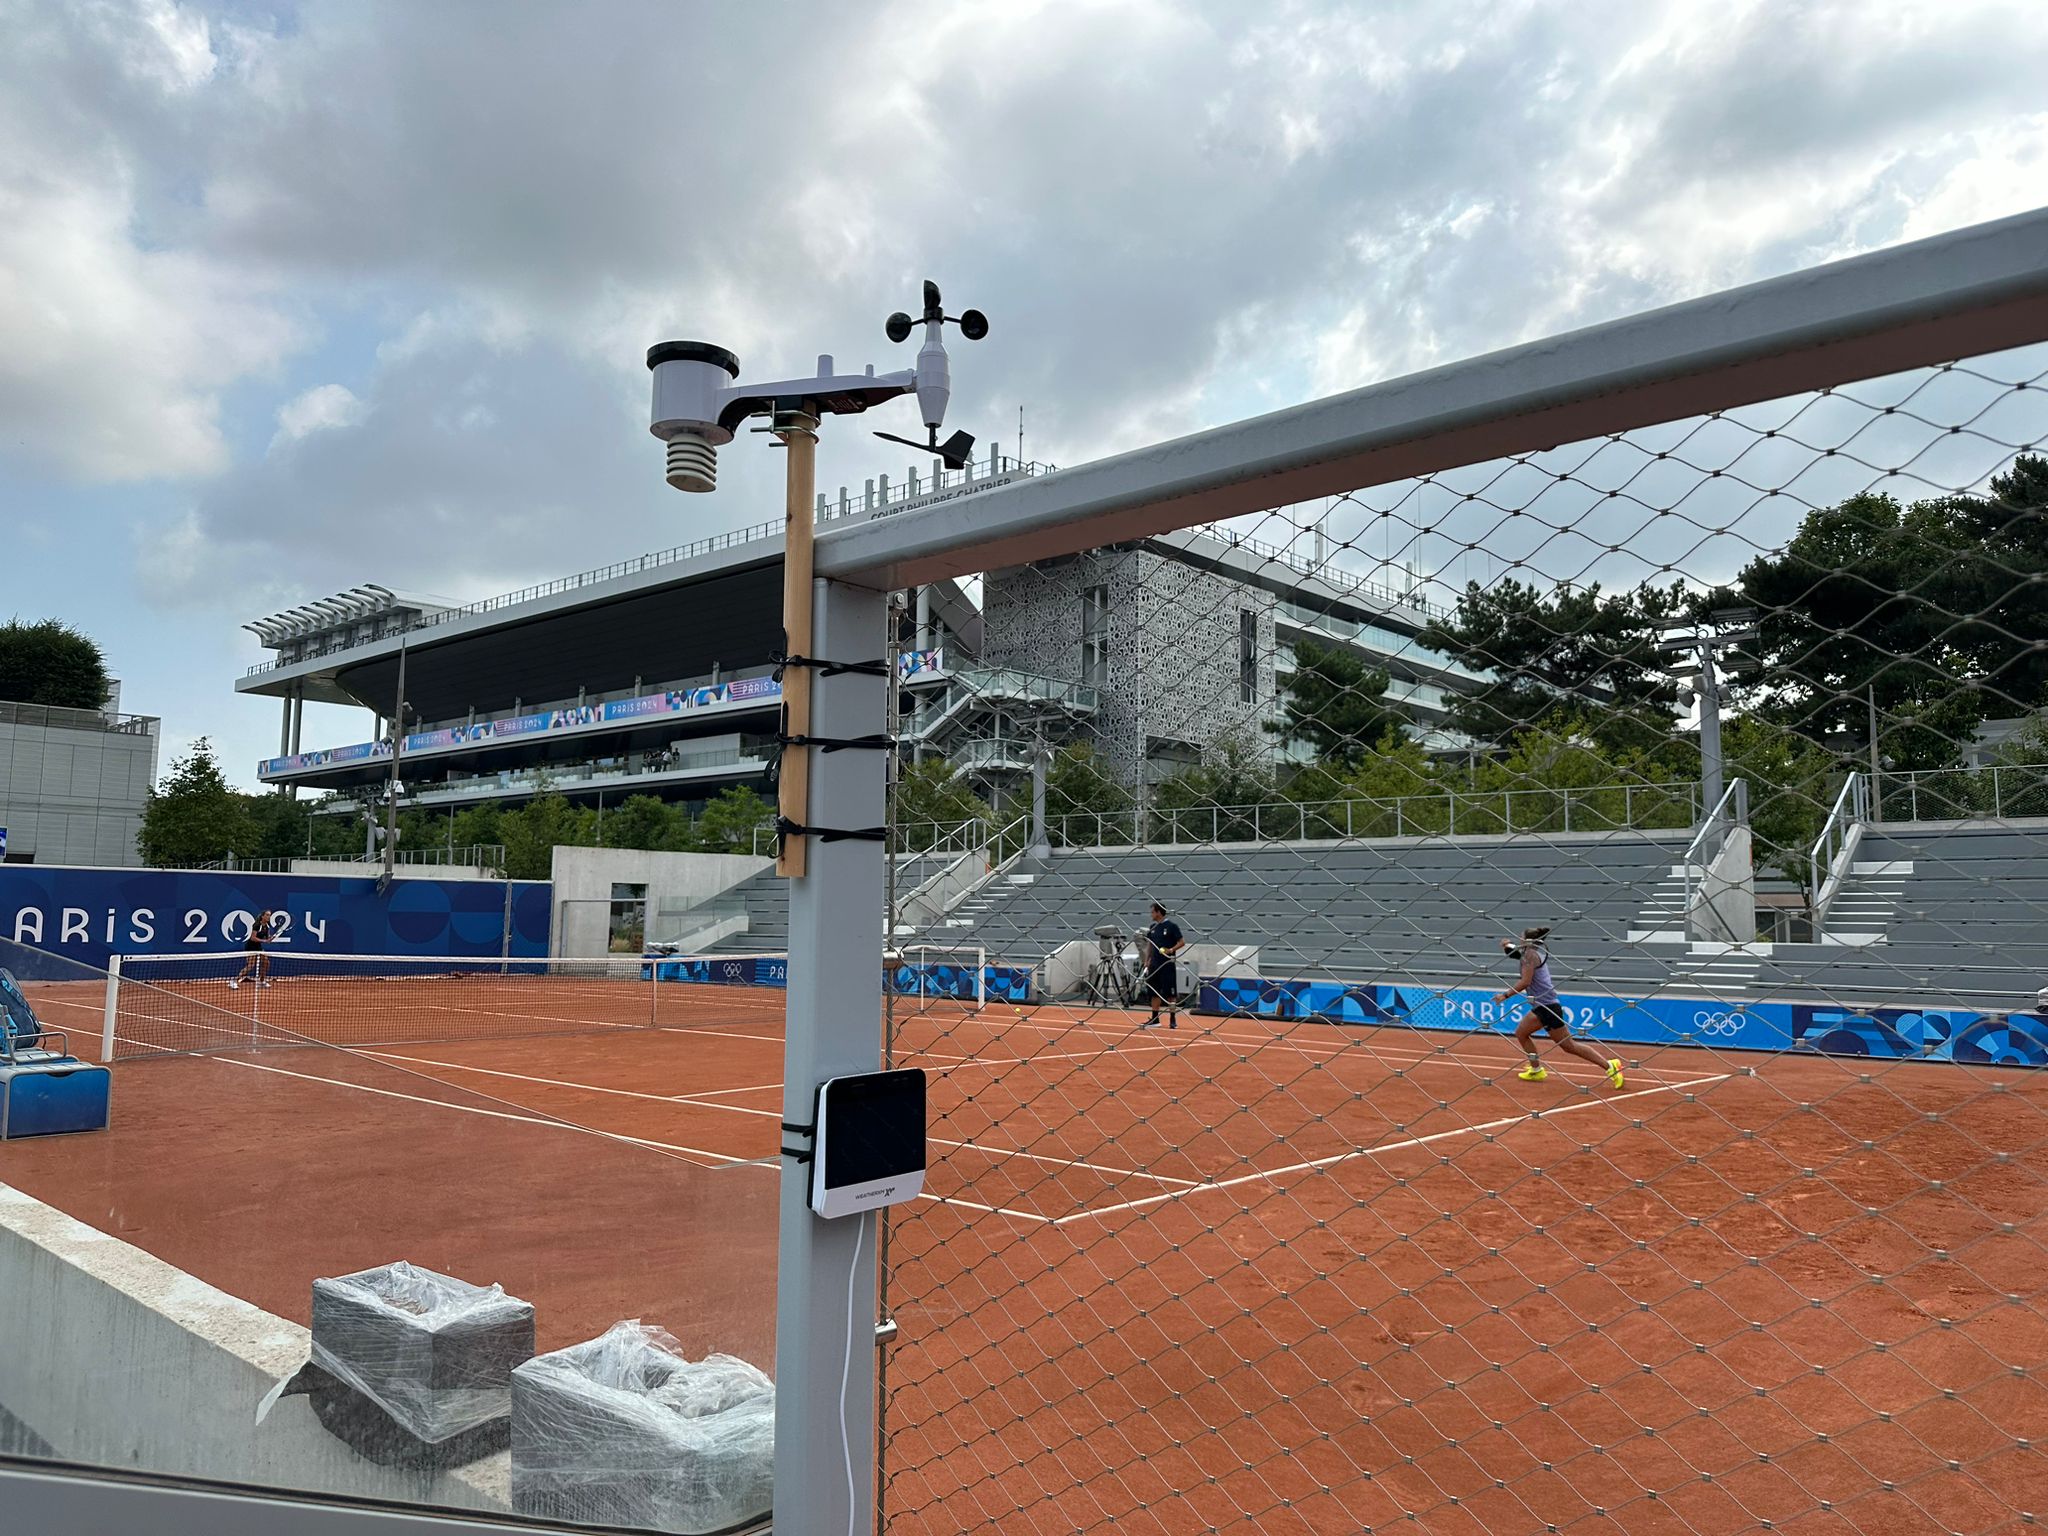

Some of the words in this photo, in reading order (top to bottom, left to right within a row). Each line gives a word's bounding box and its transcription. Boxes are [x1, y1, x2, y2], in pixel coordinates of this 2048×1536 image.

[742, 681, 769, 695] PARIS
[612, 703, 635, 715] PARIS
[636, 700, 657, 711] 2024
[182, 909, 326, 943] 2024
[769, 966, 787, 979] PA
